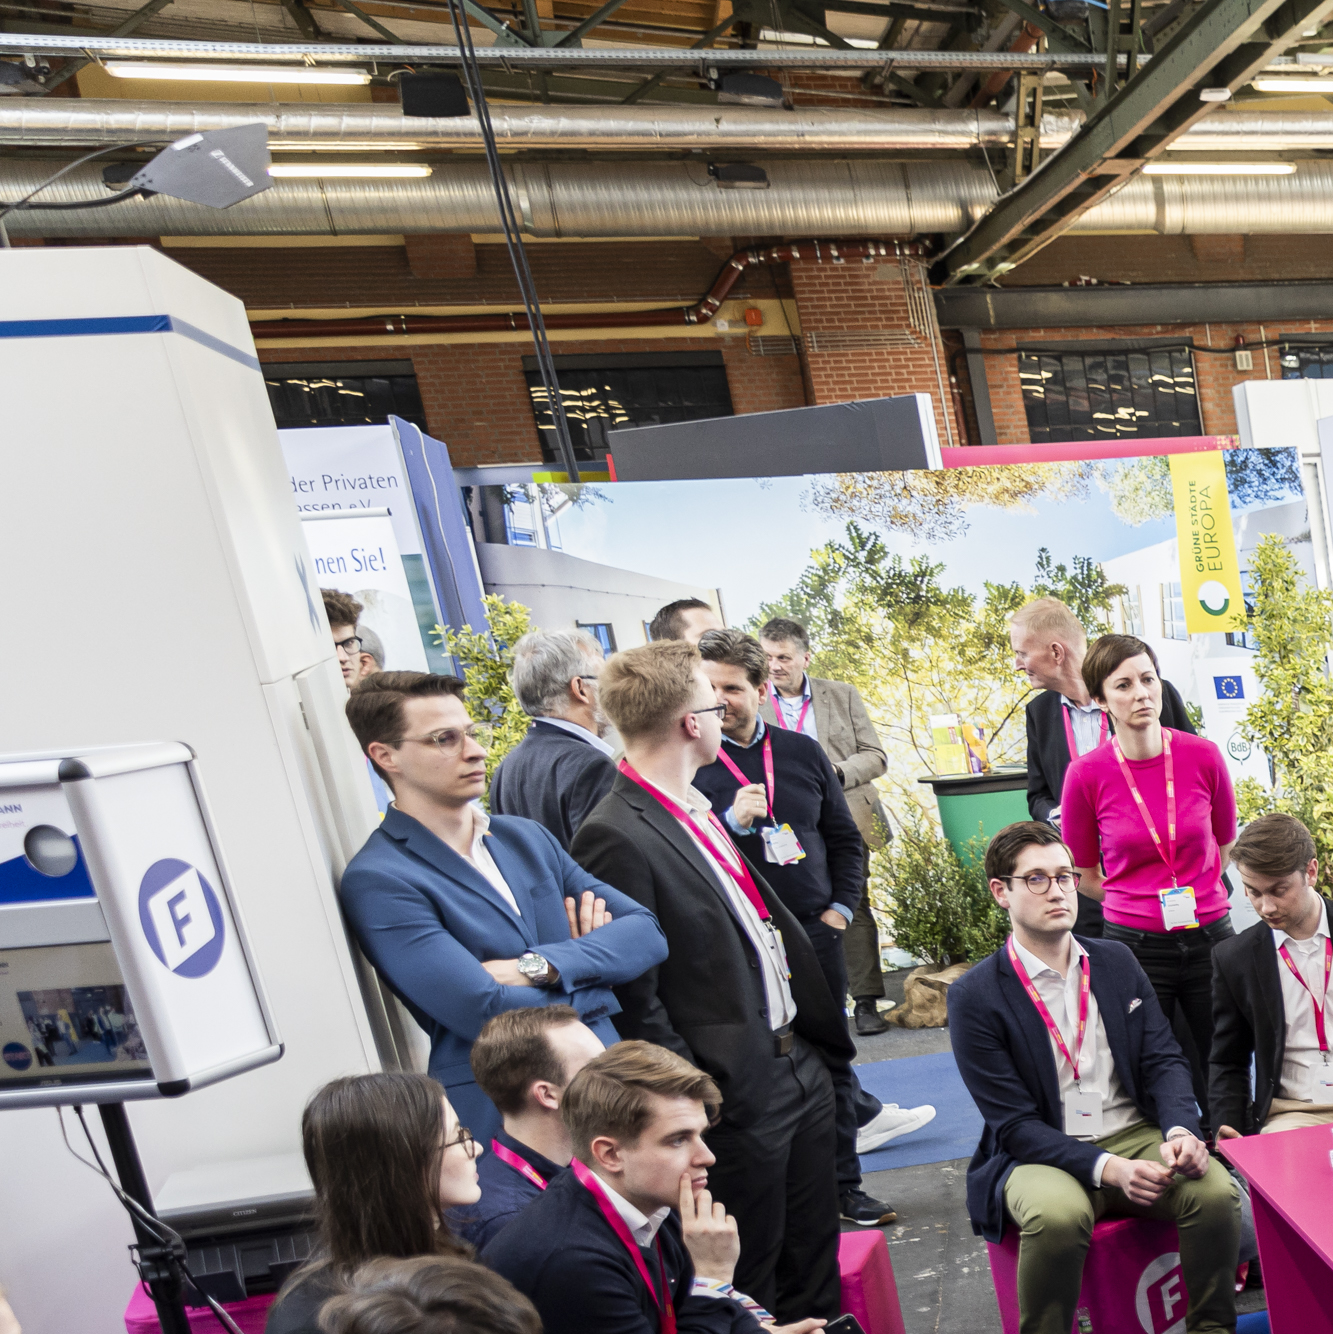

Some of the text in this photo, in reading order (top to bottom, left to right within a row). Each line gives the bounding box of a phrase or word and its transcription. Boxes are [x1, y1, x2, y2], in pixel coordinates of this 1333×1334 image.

[322, 473, 398, 491] Privaten
[1189, 480, 1205, 572] GRÜNE STÄDTE
[1199, 485, 1223, 571] EUROPA
[350, 547, 387, 572] Sie!
[1231, 742, 1247, 752] BdB
[166, 888, 194, 949] F
[1160, 1274, 1182, 1321] F
